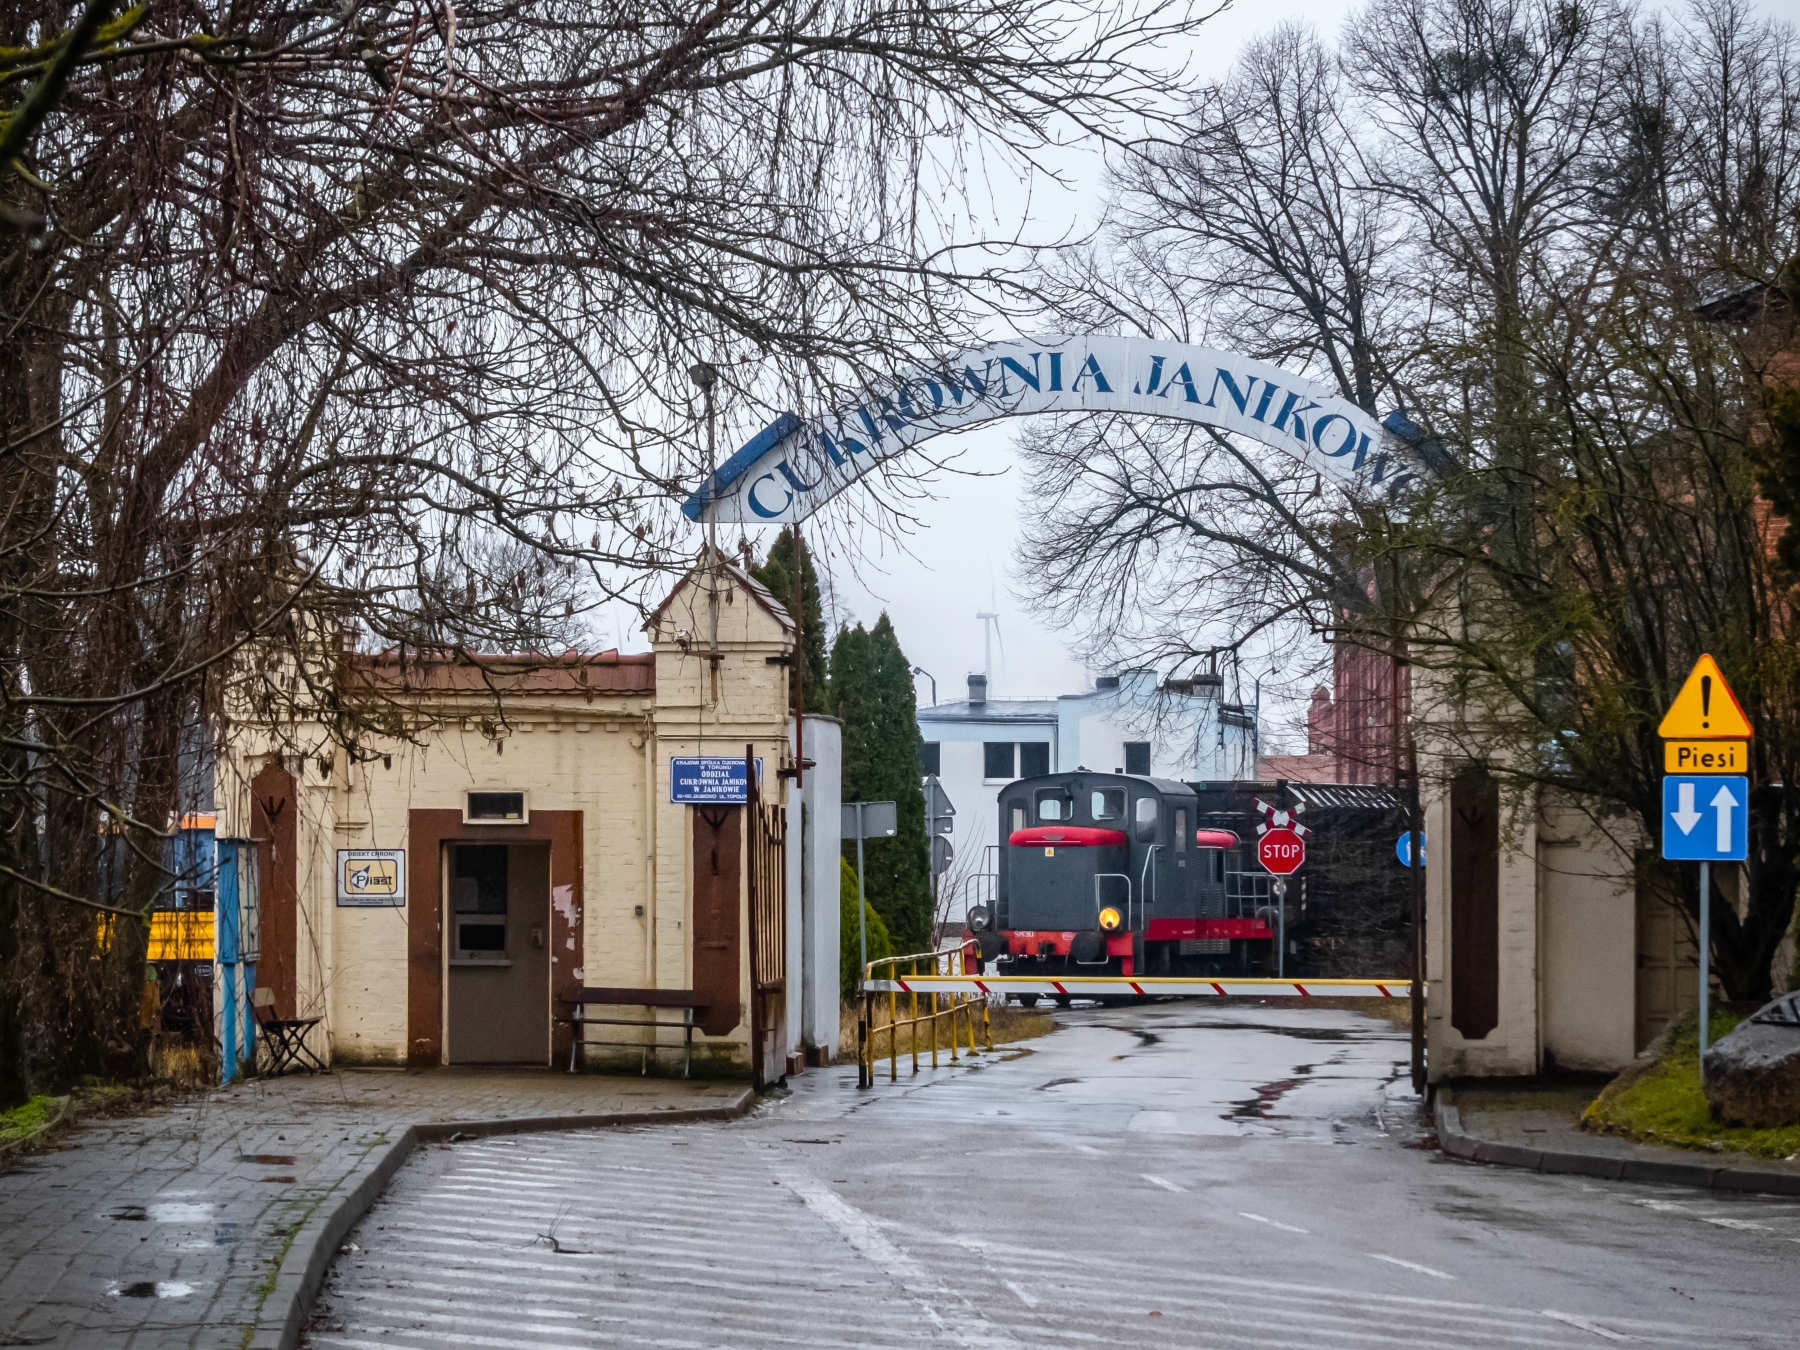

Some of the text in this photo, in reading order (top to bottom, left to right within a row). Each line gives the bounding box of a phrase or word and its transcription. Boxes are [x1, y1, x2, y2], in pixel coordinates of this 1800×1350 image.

[748, 351, 1115, 519] CUKROWNIA
[1677, 746, 1735, 768] Piesi
[701, 770, 730, 778] ODDZIAŁ
[1263, 844, 1300, 859] STOP
[356, 875, 393, 886] Piast
